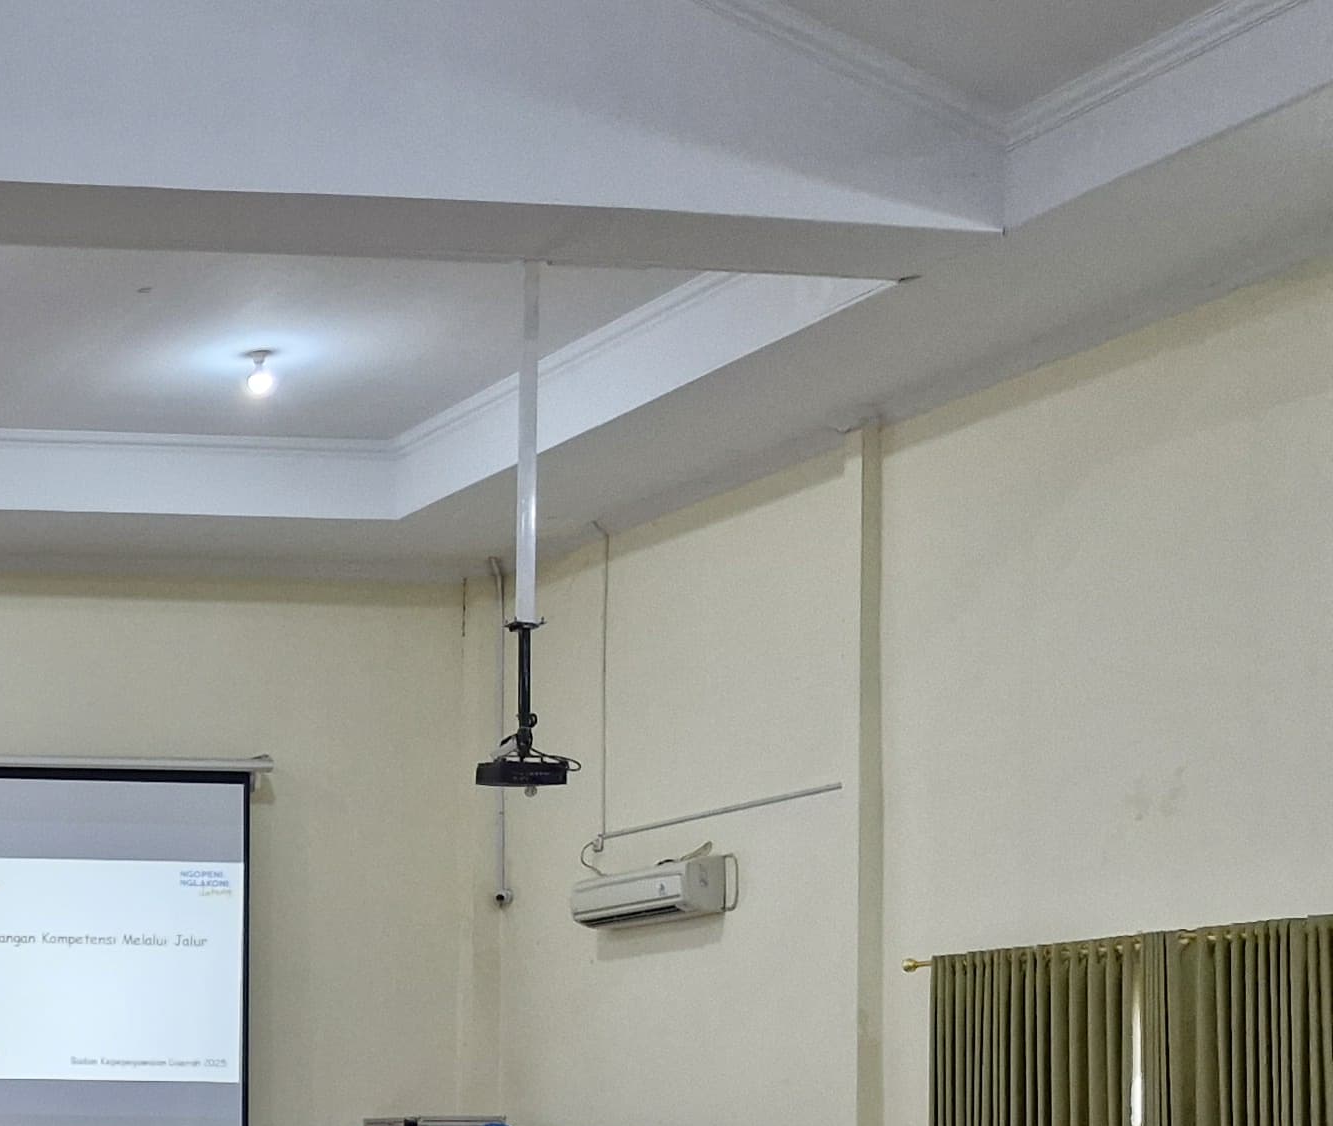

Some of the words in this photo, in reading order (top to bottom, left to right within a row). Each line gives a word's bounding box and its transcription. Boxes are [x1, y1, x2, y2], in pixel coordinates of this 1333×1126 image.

[41, 932, 117, 948] Kompetensi
[121, 934, 168, 946] Melalui
[173, 934, 209, 947] Jalur
